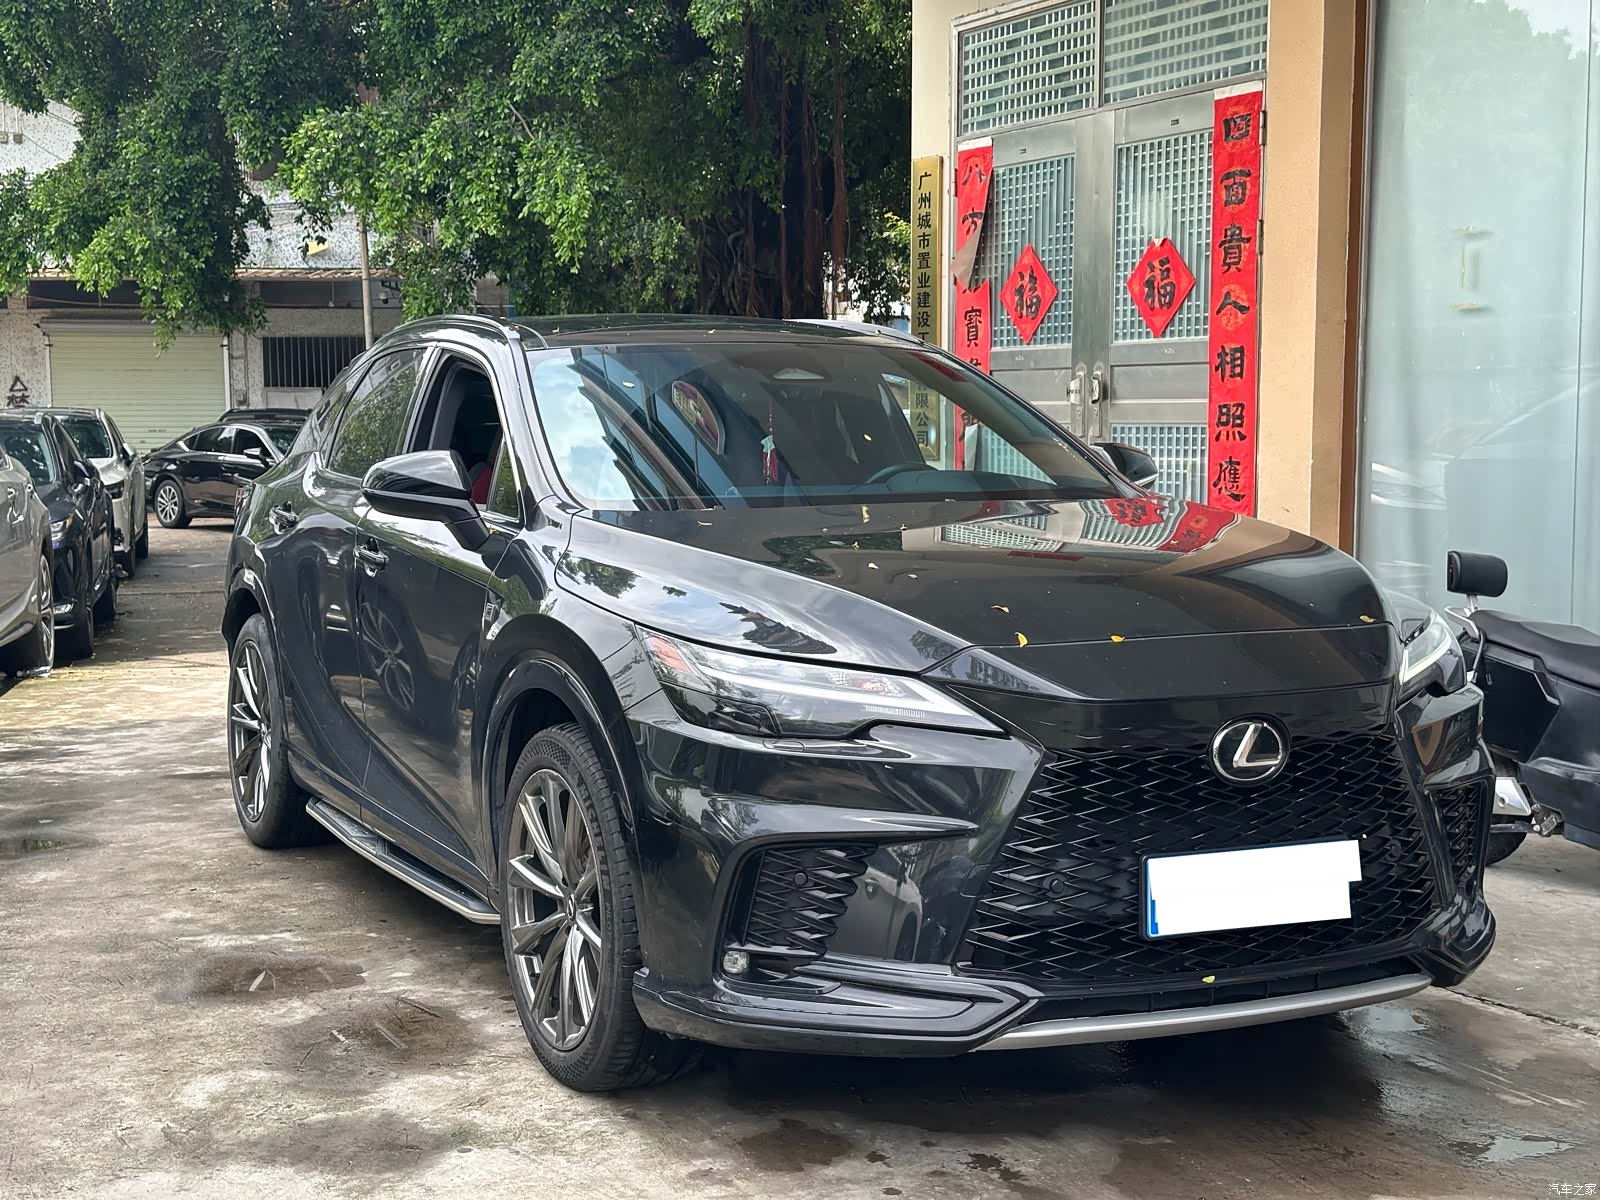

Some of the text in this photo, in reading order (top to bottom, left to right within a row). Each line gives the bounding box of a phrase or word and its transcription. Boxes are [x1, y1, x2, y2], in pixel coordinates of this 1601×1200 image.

[1014, 266, 1041, 320] 福
[1143, 256, 1176, 312] 福
[577, 783, 611, 890] MICHELIN
